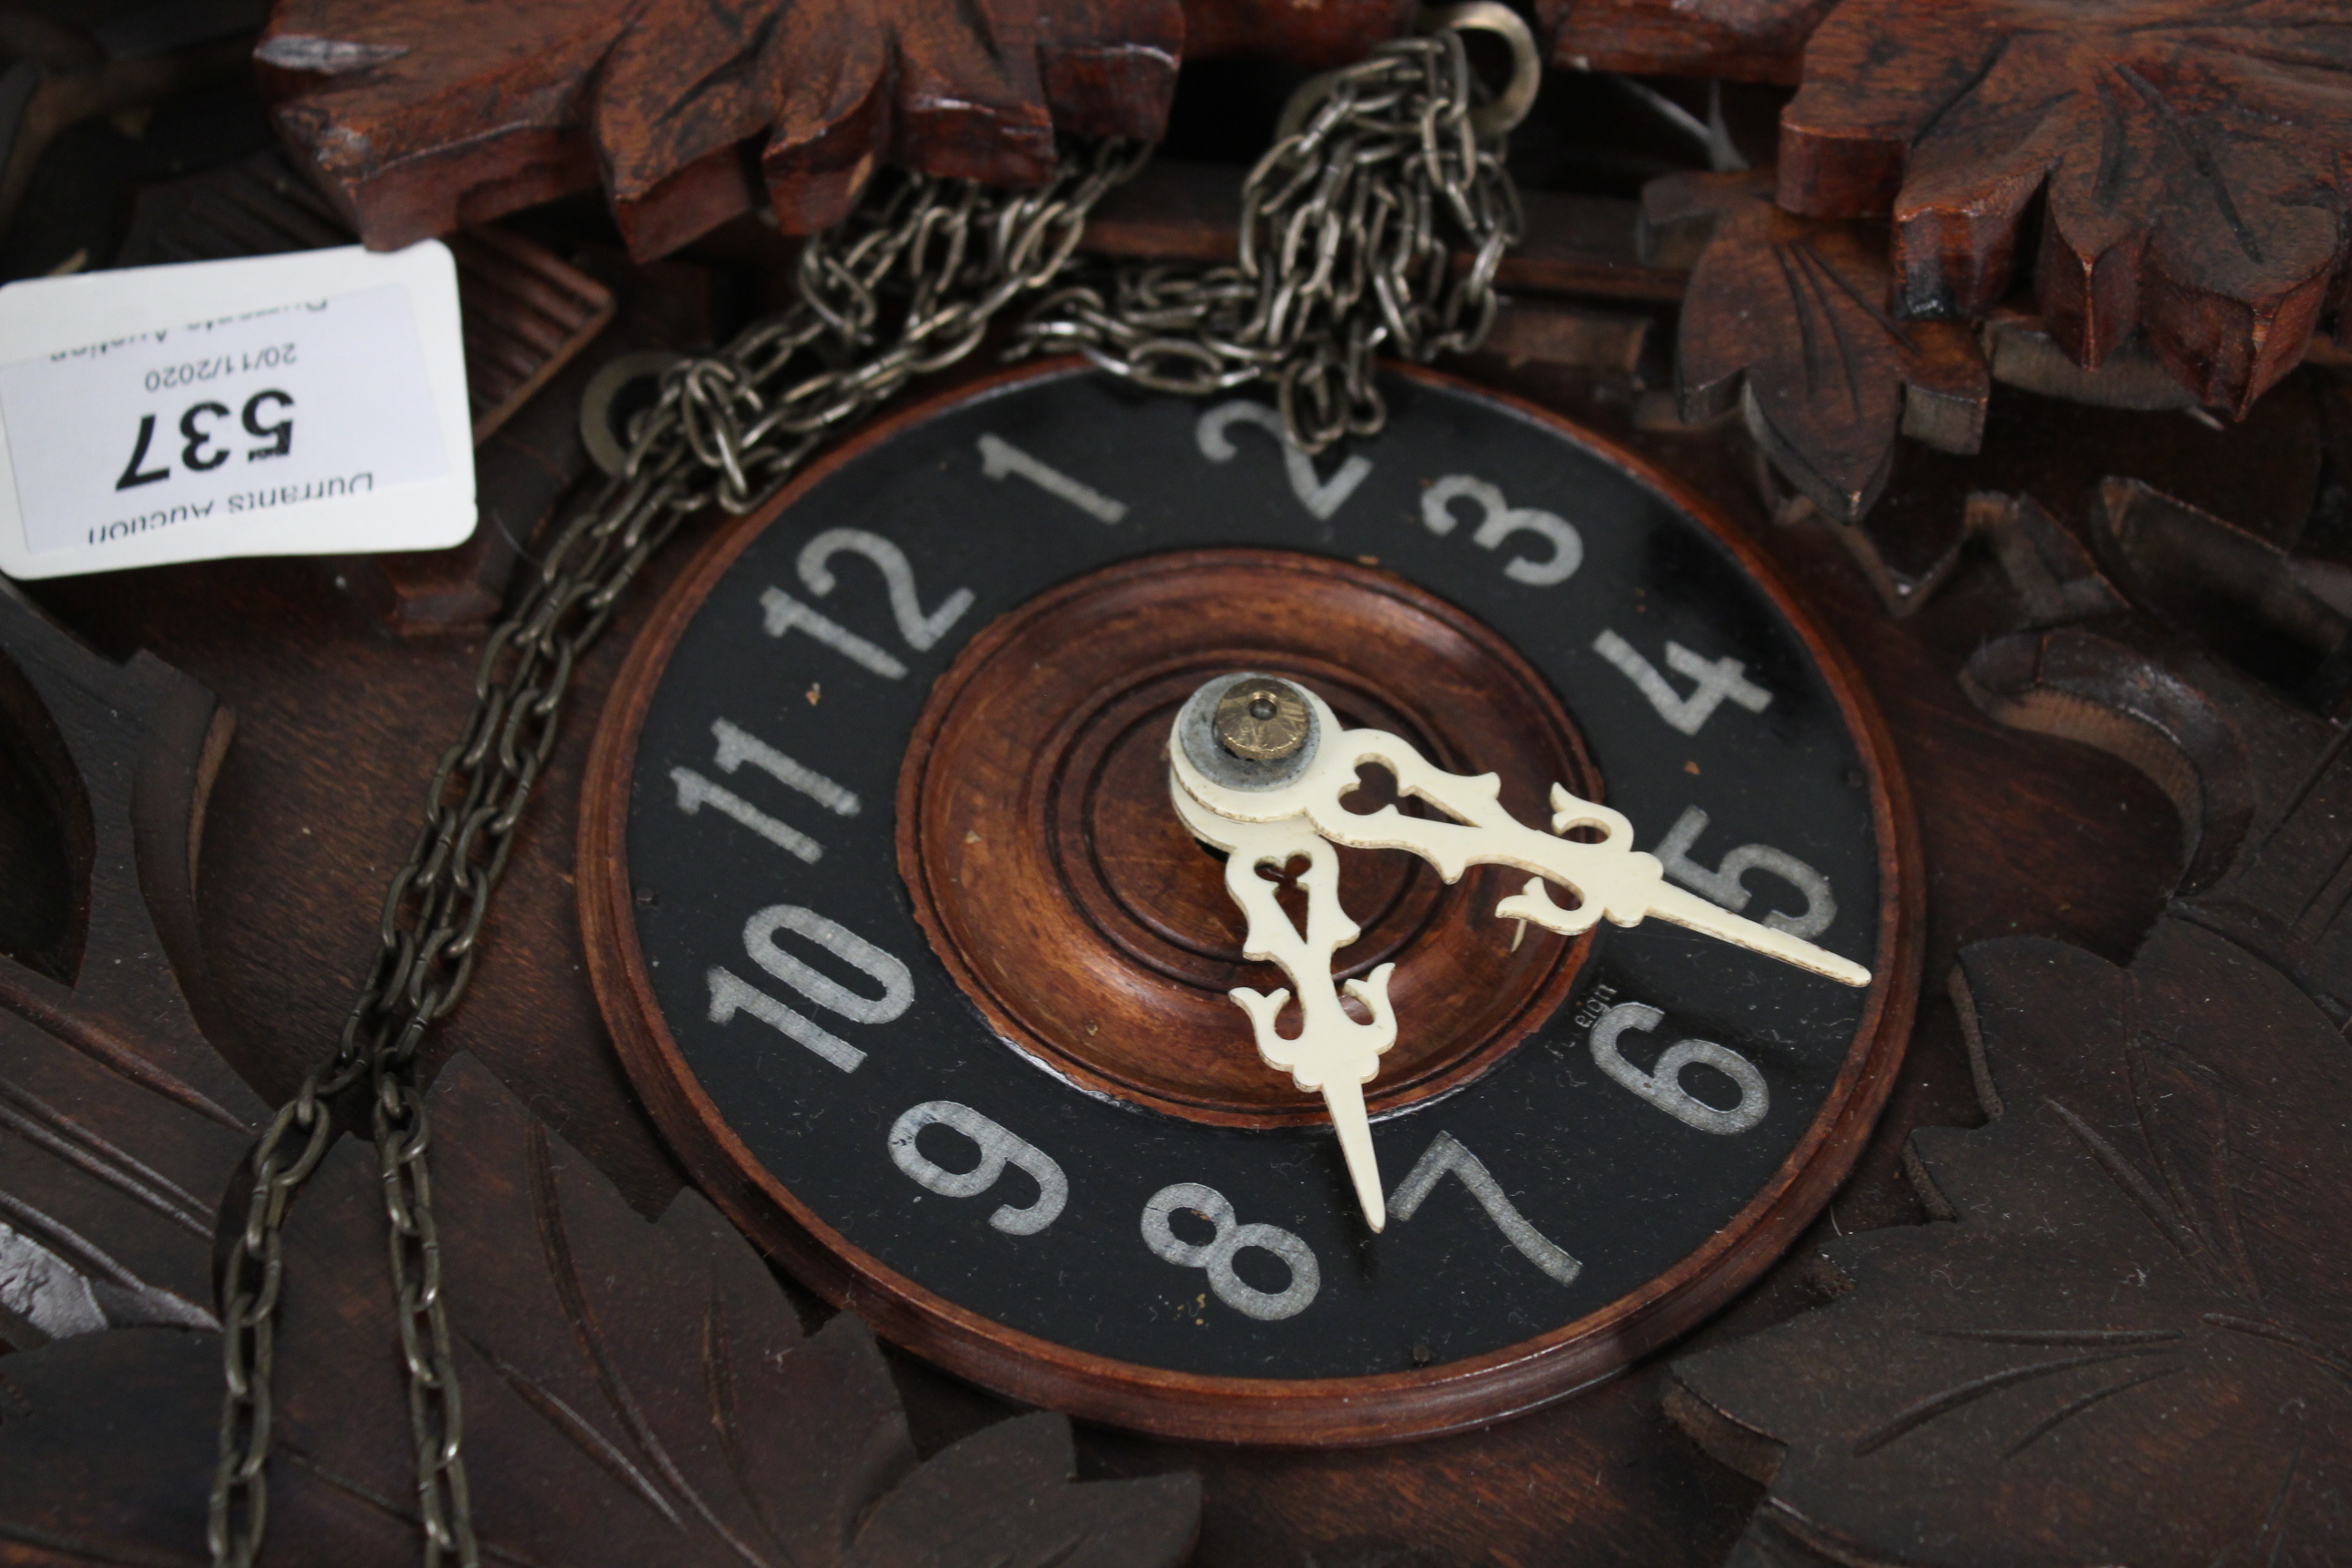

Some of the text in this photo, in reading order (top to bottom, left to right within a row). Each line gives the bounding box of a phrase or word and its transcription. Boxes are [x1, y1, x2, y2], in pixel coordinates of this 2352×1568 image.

[145, 343, 298, 391] 20/11/2020
[114, 388, 296, 492] 537
[228, 472, 373, 514] Durrants
[979, 436, 1124, 523] 1
[1195, 399, 1371, 520] 2
[1421, 475, 1584, 586] 3
[761, 529, 974, 679] 12
[1593, 630, 1771, 736] 4
[670, 719, 860, 864] 11
[1650, 804, 1838, 941] 5
[708, 904, 916, 1073] 10
[1590, 1000, 1769, 1135] 6
[887, 1100, 1070, 1237] 9
[1386, 1130, 1583, 1284] 7
[1140, 1181, 1321, 1322] 8
